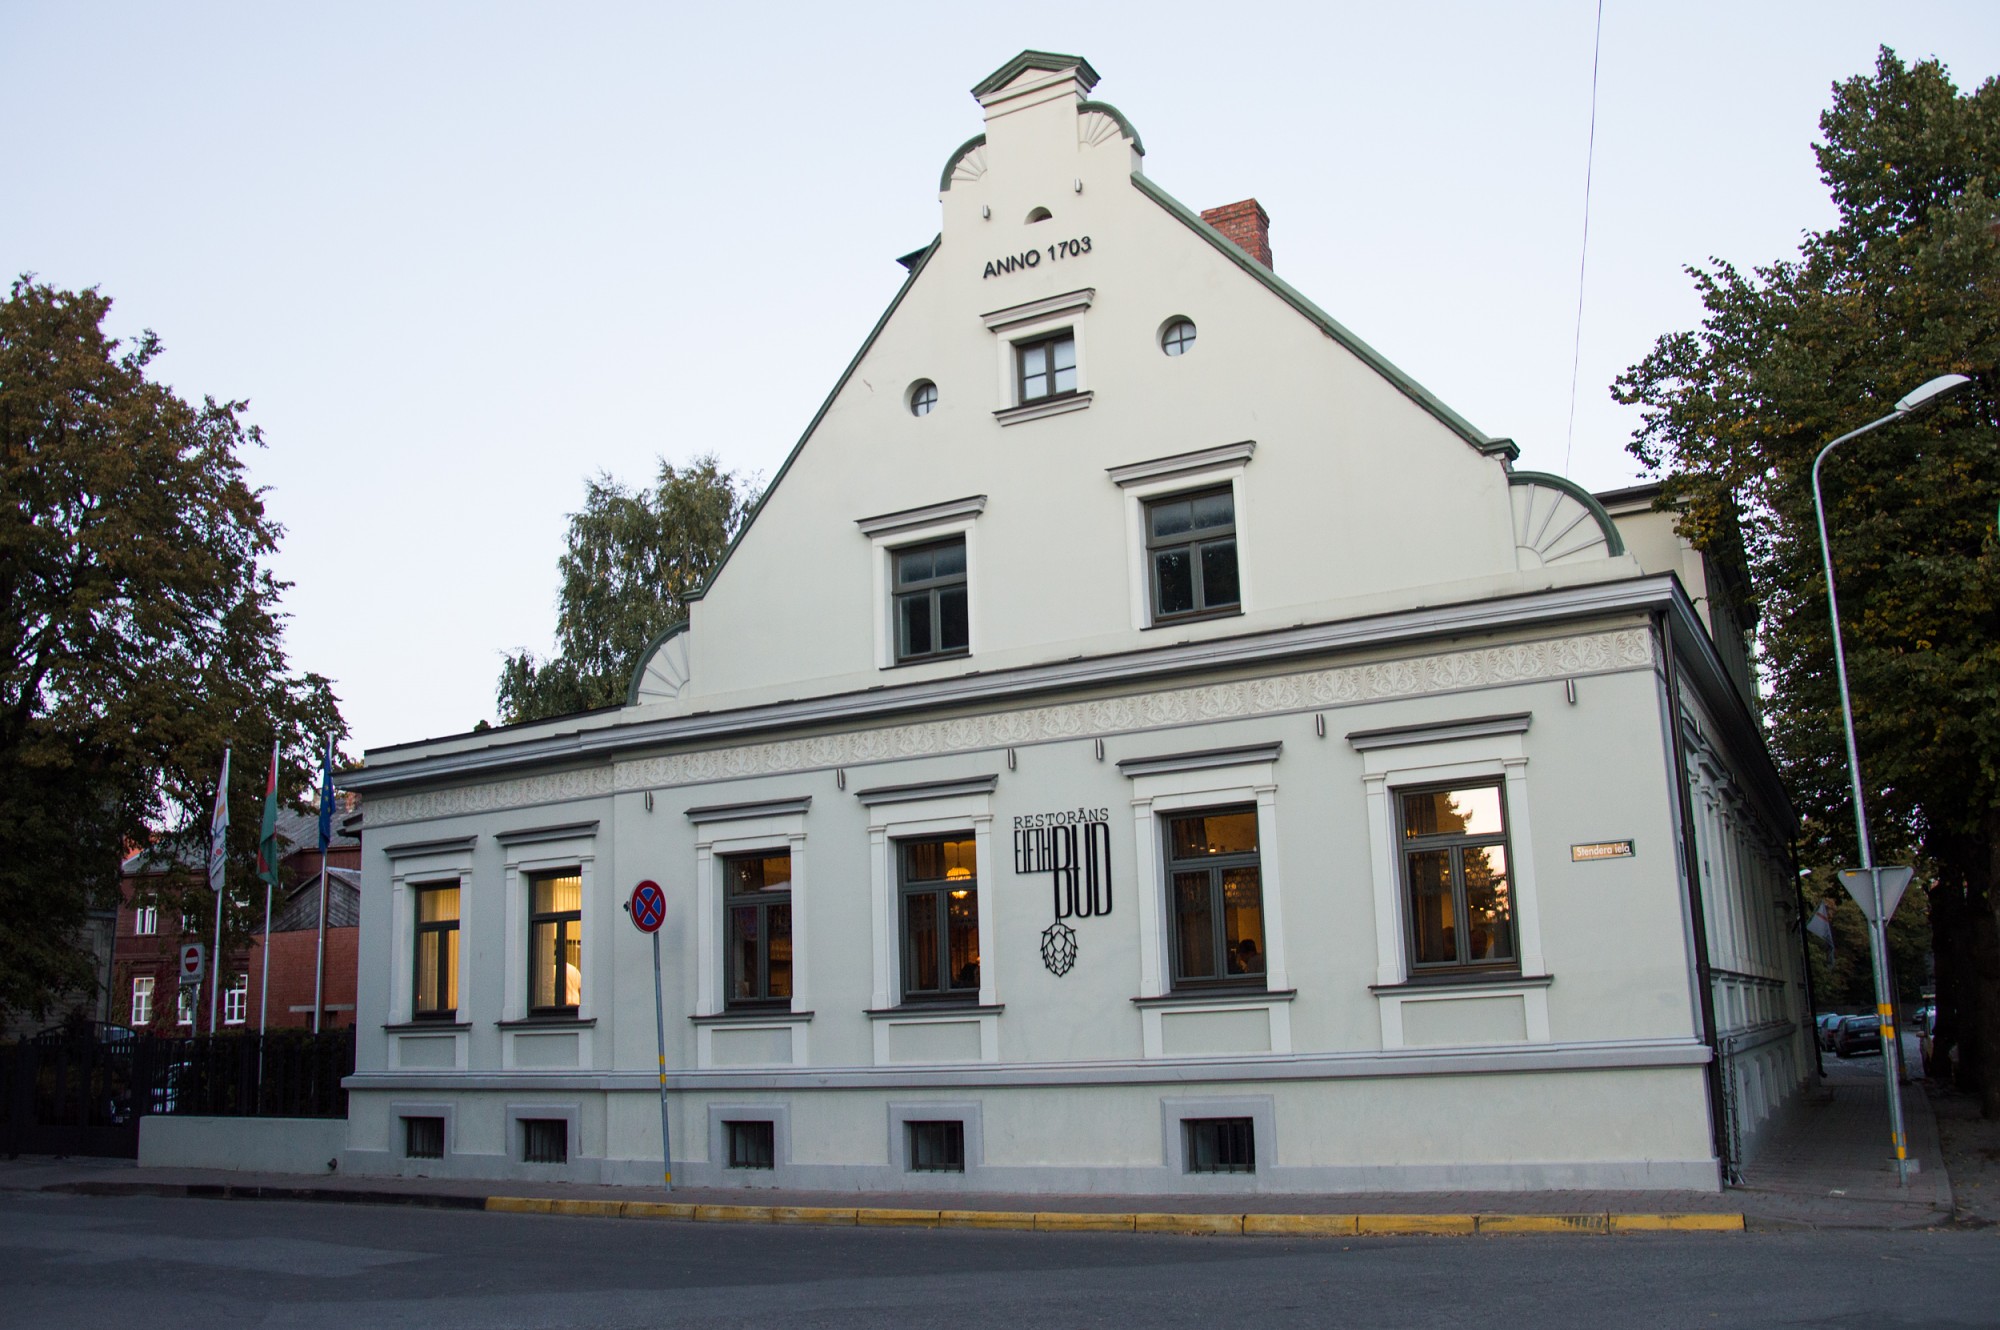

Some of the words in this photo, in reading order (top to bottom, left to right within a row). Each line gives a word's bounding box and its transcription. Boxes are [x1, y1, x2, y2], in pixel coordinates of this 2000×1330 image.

[983, 249, 1041, 279] ANNO
[1047, 236, 1093, 261] 1703
[1013, 807, 1109, 829] RESTORĀNS
[1576, 844, 1613, 857] Stendera
[1614, 842, 1630, 853] iela
[1052, 822, 1113, 918] BUD
